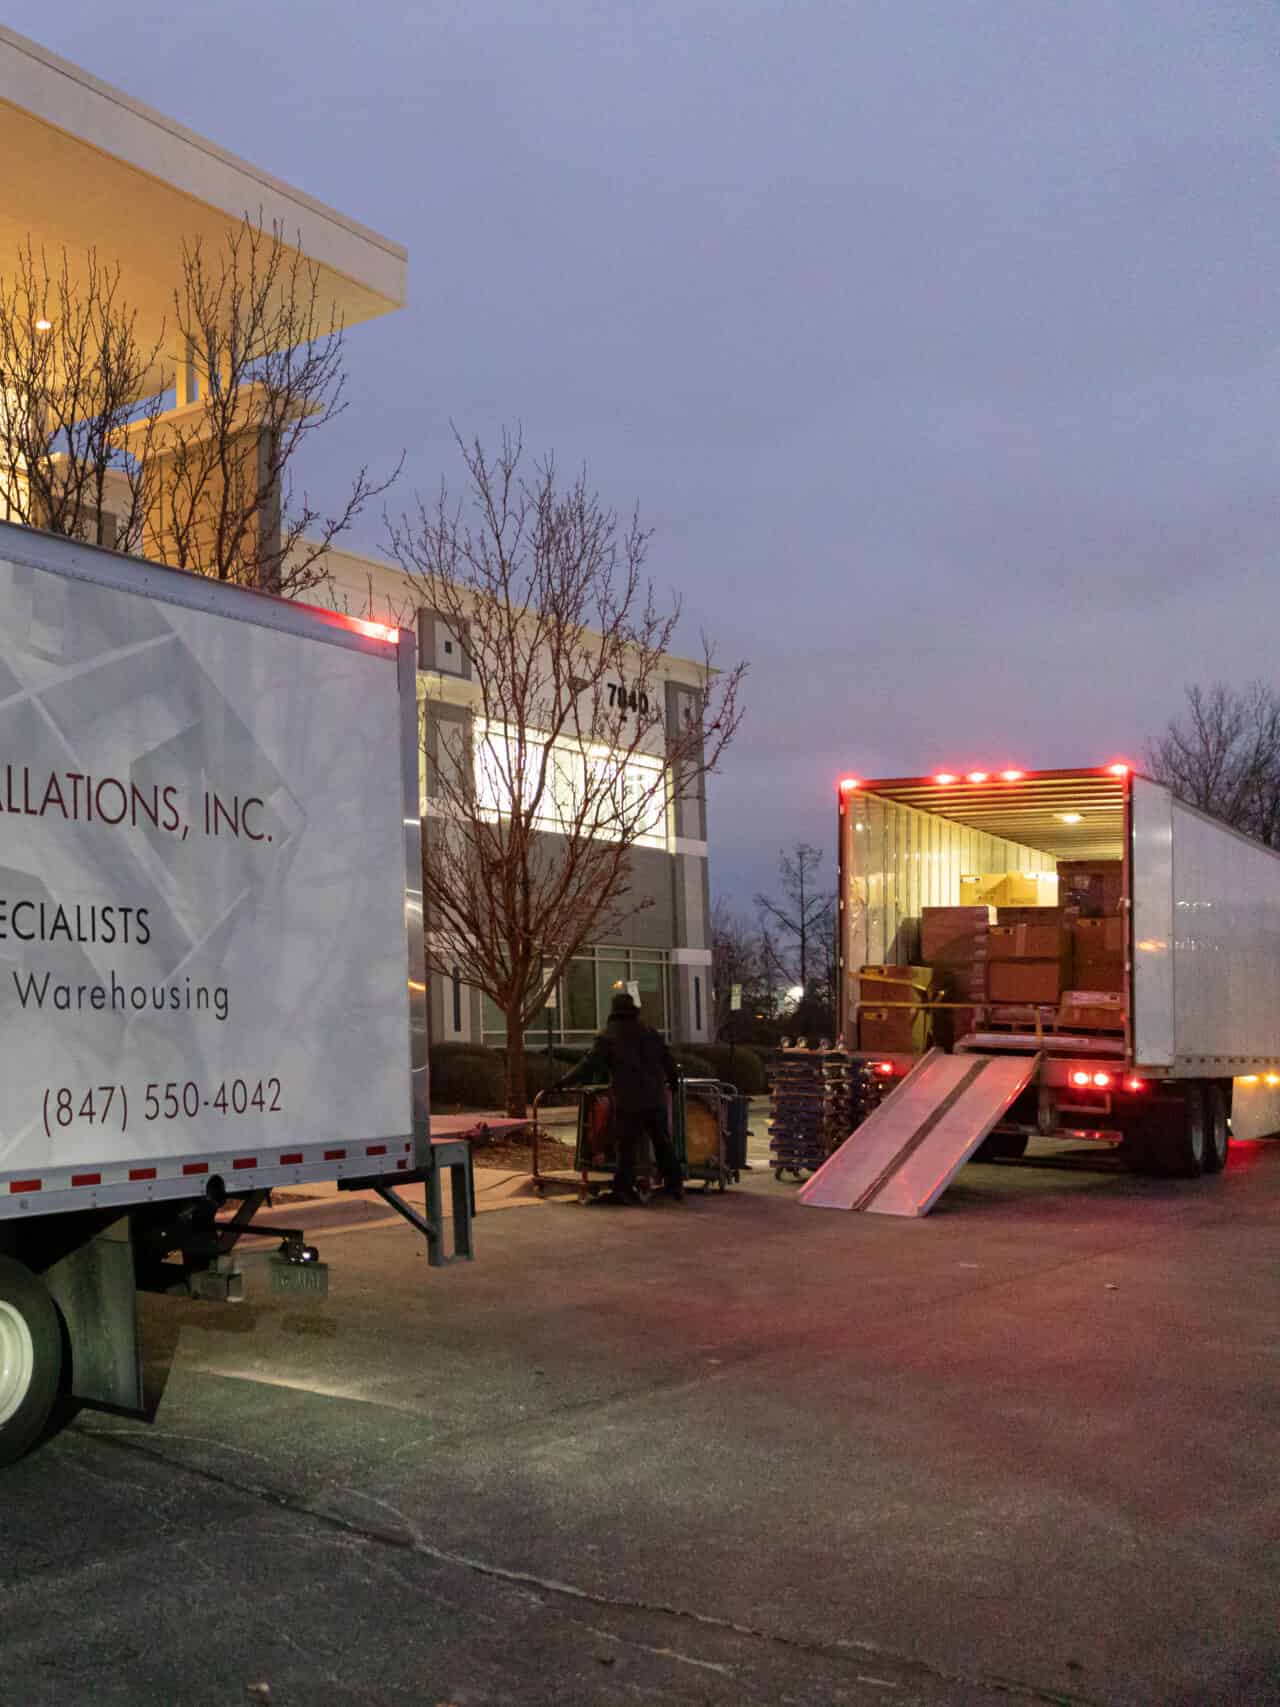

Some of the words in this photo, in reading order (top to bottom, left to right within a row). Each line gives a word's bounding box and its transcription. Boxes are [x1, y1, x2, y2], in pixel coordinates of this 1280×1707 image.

[204, 791, 274, 842] INC.
[12, 970, 230, 1021] Warehousing
[42, 1085, 129, 1138] (847)
[144, 1077, 282, 1121] 550-4042
